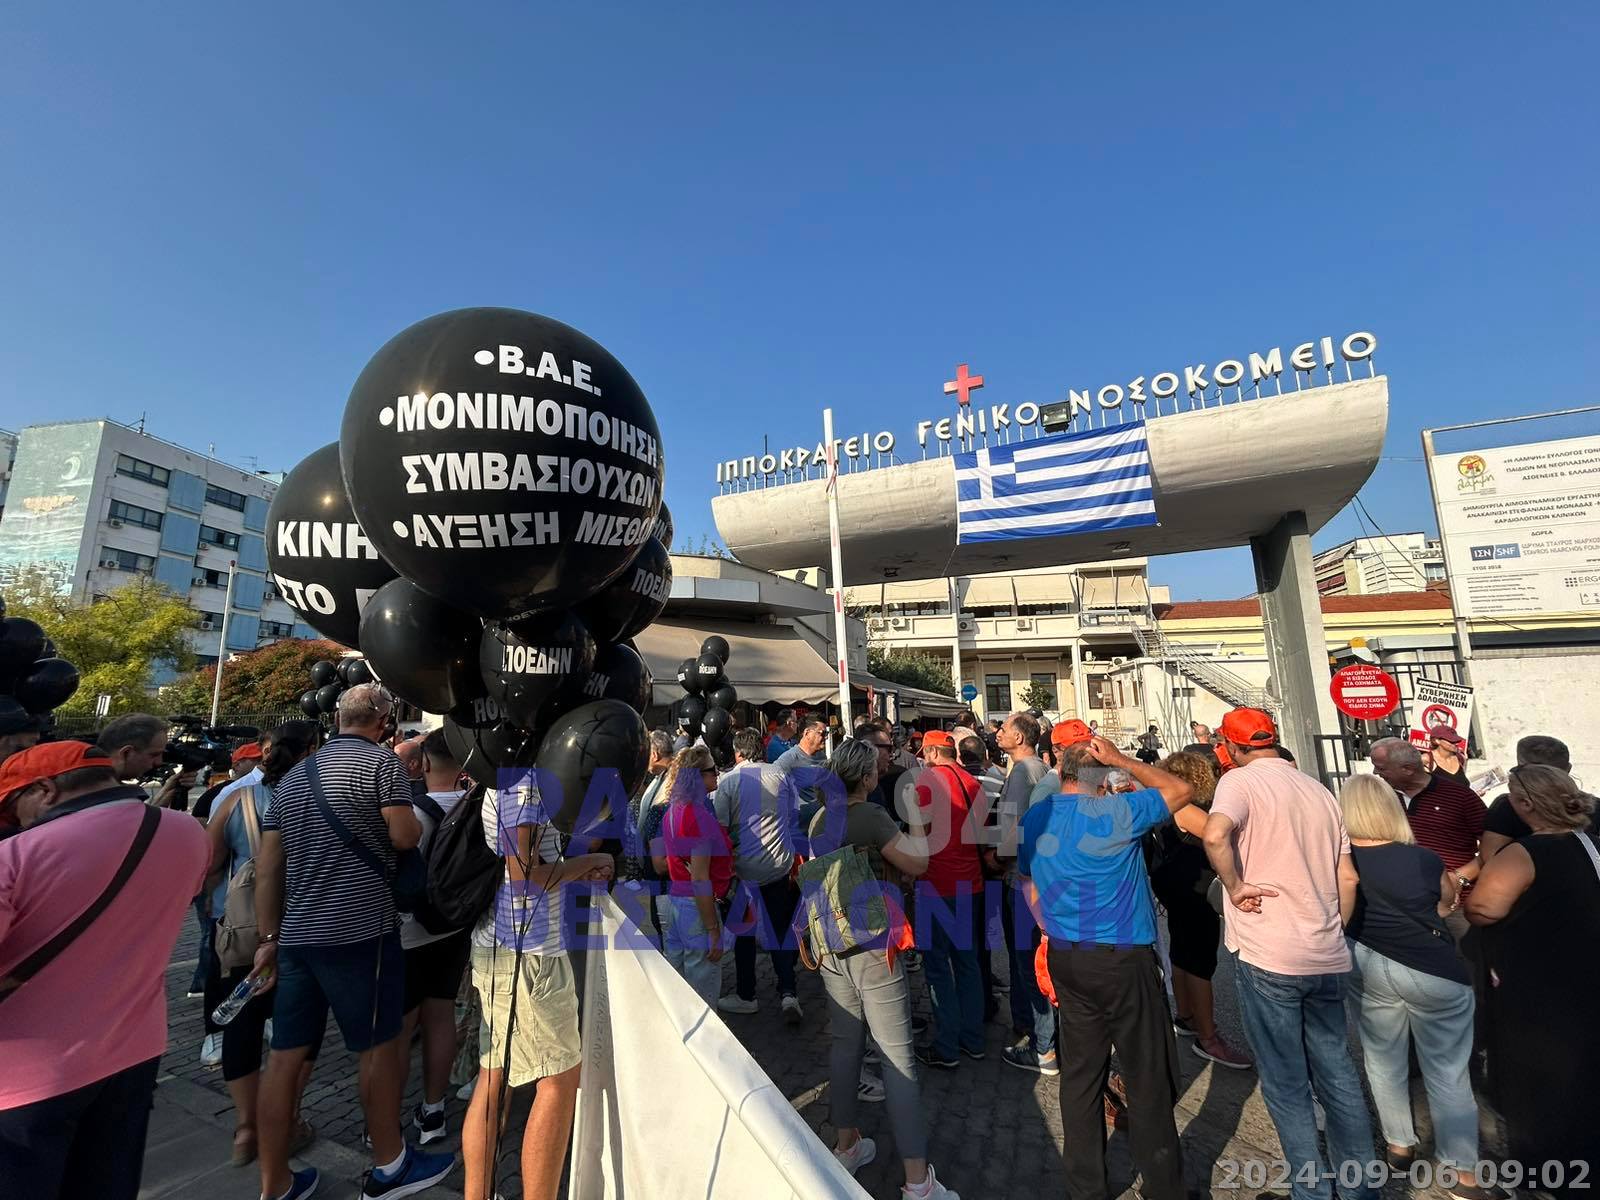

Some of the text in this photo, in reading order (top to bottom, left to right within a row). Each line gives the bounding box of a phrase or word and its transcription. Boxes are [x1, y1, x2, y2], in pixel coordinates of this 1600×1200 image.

[917, 402, 1040, 446] ΓΕΝΙΚΟ
[1069, 332, 1377, 417] ΝΟΣΟΚΟΜΕΙΟ
[397, 392, 658, 468] ΜΟΝΙΜΟΠΟΙΗΣΗ
[401, 451, 655, 509] ΣΥΜΒΑΣΙΟΥΧΩΝ
[1567, 492, 1600, 501] ΕΡΓΑΣΤΗΡ
[277, 520, 380, 561] ΚΙΝΗ
[414, 511, 560, 548] ΑΥΞΗΣΗ
[502, 645, 572, 675] ΠΟΕΔΗΝ
[1417, 693, 1468, 709] ΔΟΛΟΦΟΝΩΝ
[1420, 686, 1467, 702] ΚΥΒΕΡΝΗΣΗ
